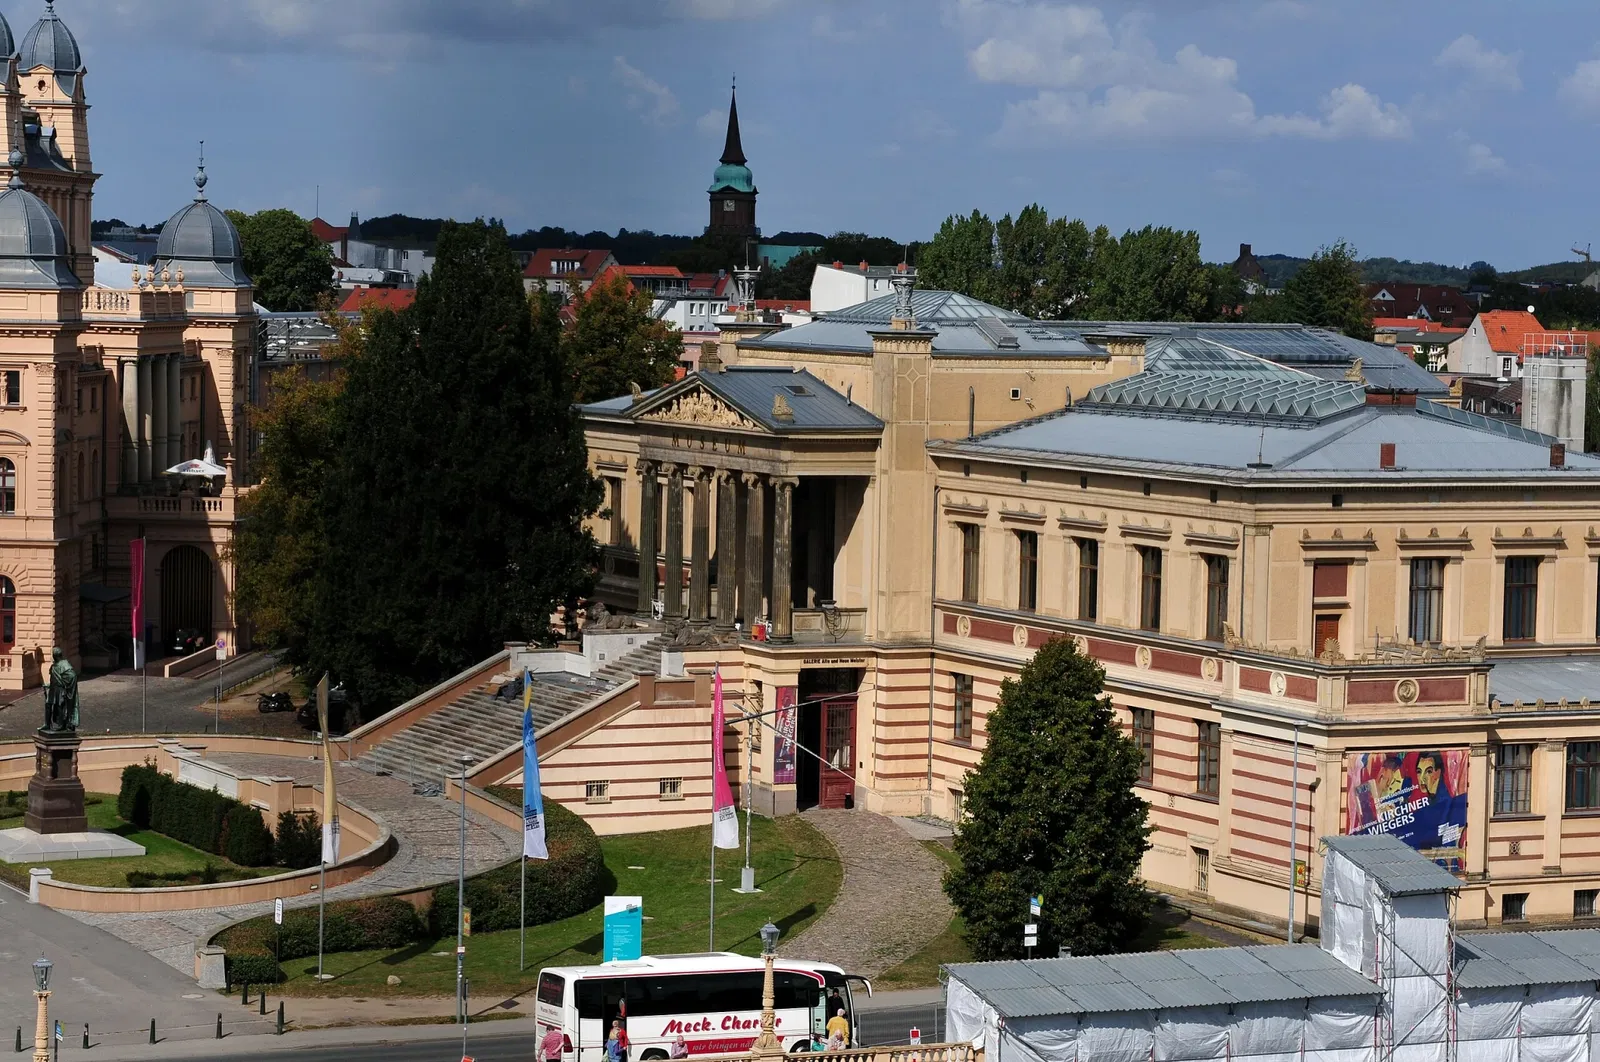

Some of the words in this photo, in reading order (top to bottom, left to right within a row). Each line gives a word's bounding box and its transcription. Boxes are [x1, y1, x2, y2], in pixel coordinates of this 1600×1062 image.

[672, 433, 745, 455] MUSEUM
[1377, 796, 1430, 823] KIRCHNER
[1368, 812, 1415, 836] WIEGERS
[660, 1016, 716, 1037] Meck.
[721, 1015, 782, 1030] Charr
[708, 1041, 738, 1051] bringen
